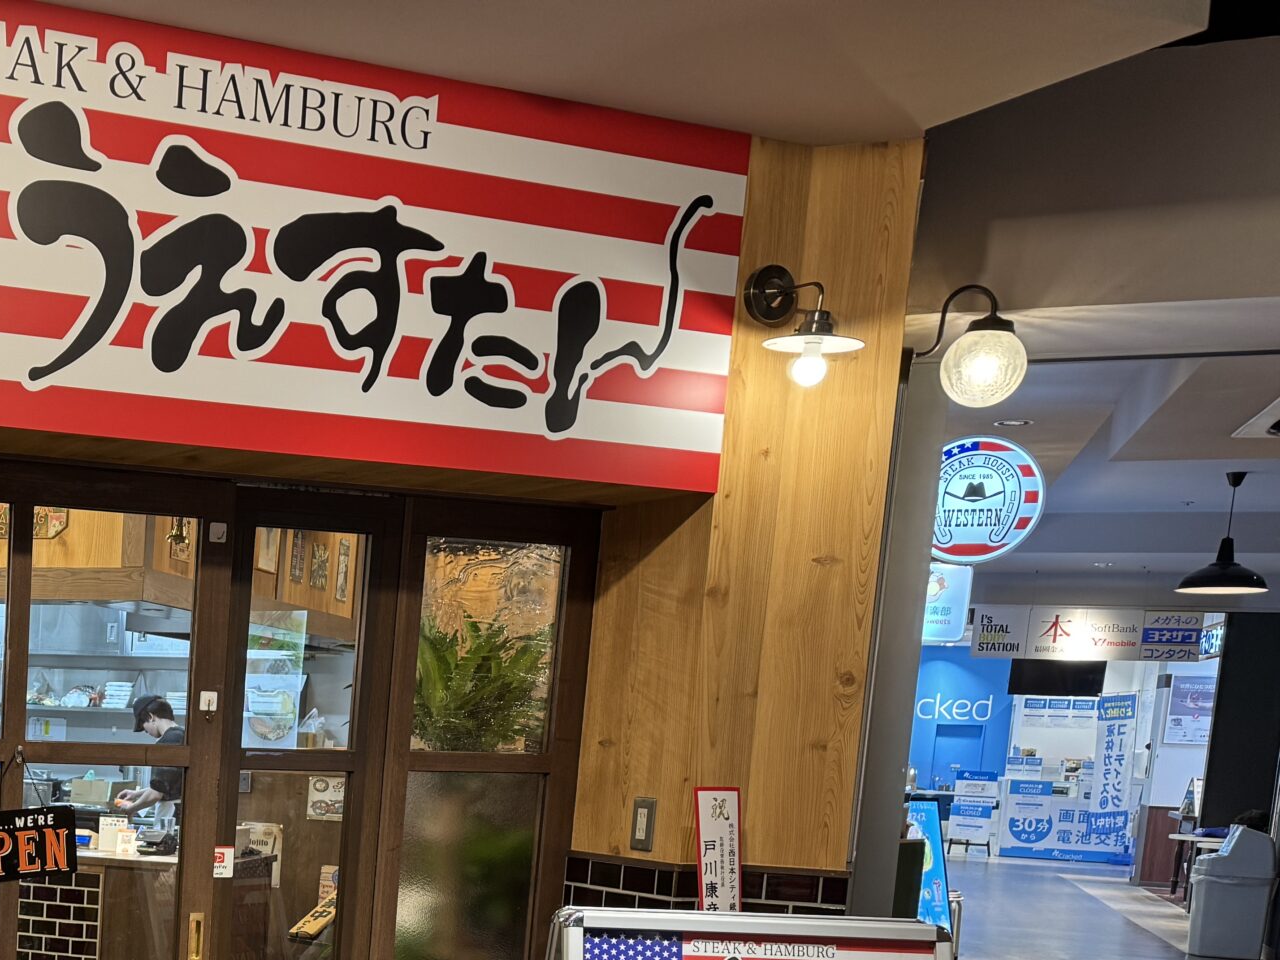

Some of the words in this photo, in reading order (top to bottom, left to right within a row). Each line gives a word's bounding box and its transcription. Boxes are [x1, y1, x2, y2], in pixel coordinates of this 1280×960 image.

[108, 52, 147, 102] &
[173, 64, 434, 150] HAMBURG
[983, 456, 1015, 482] HOUSE
[943, 508, 1003, 527] WESTERN
[1091, 623, 1138, 633] SoftBank
[1152, 616, 1199, 626] メガネの
[981, 624, 1010, 634] TOTAL
[979, 634, 1006, 642] BODY
[978, 642, 1019, 652] STATION
[1143, 648, 1196, 659] コンタクト
[916, 693, 993, 721] cked
[711, 797, 730, 821] 祝
[1012, 818, 1049, 832] 30分
[692, 940, 743, 955] STEAK
[747, 942, 758, 955] &
[764, 943, 836, 959] HAMBURG
